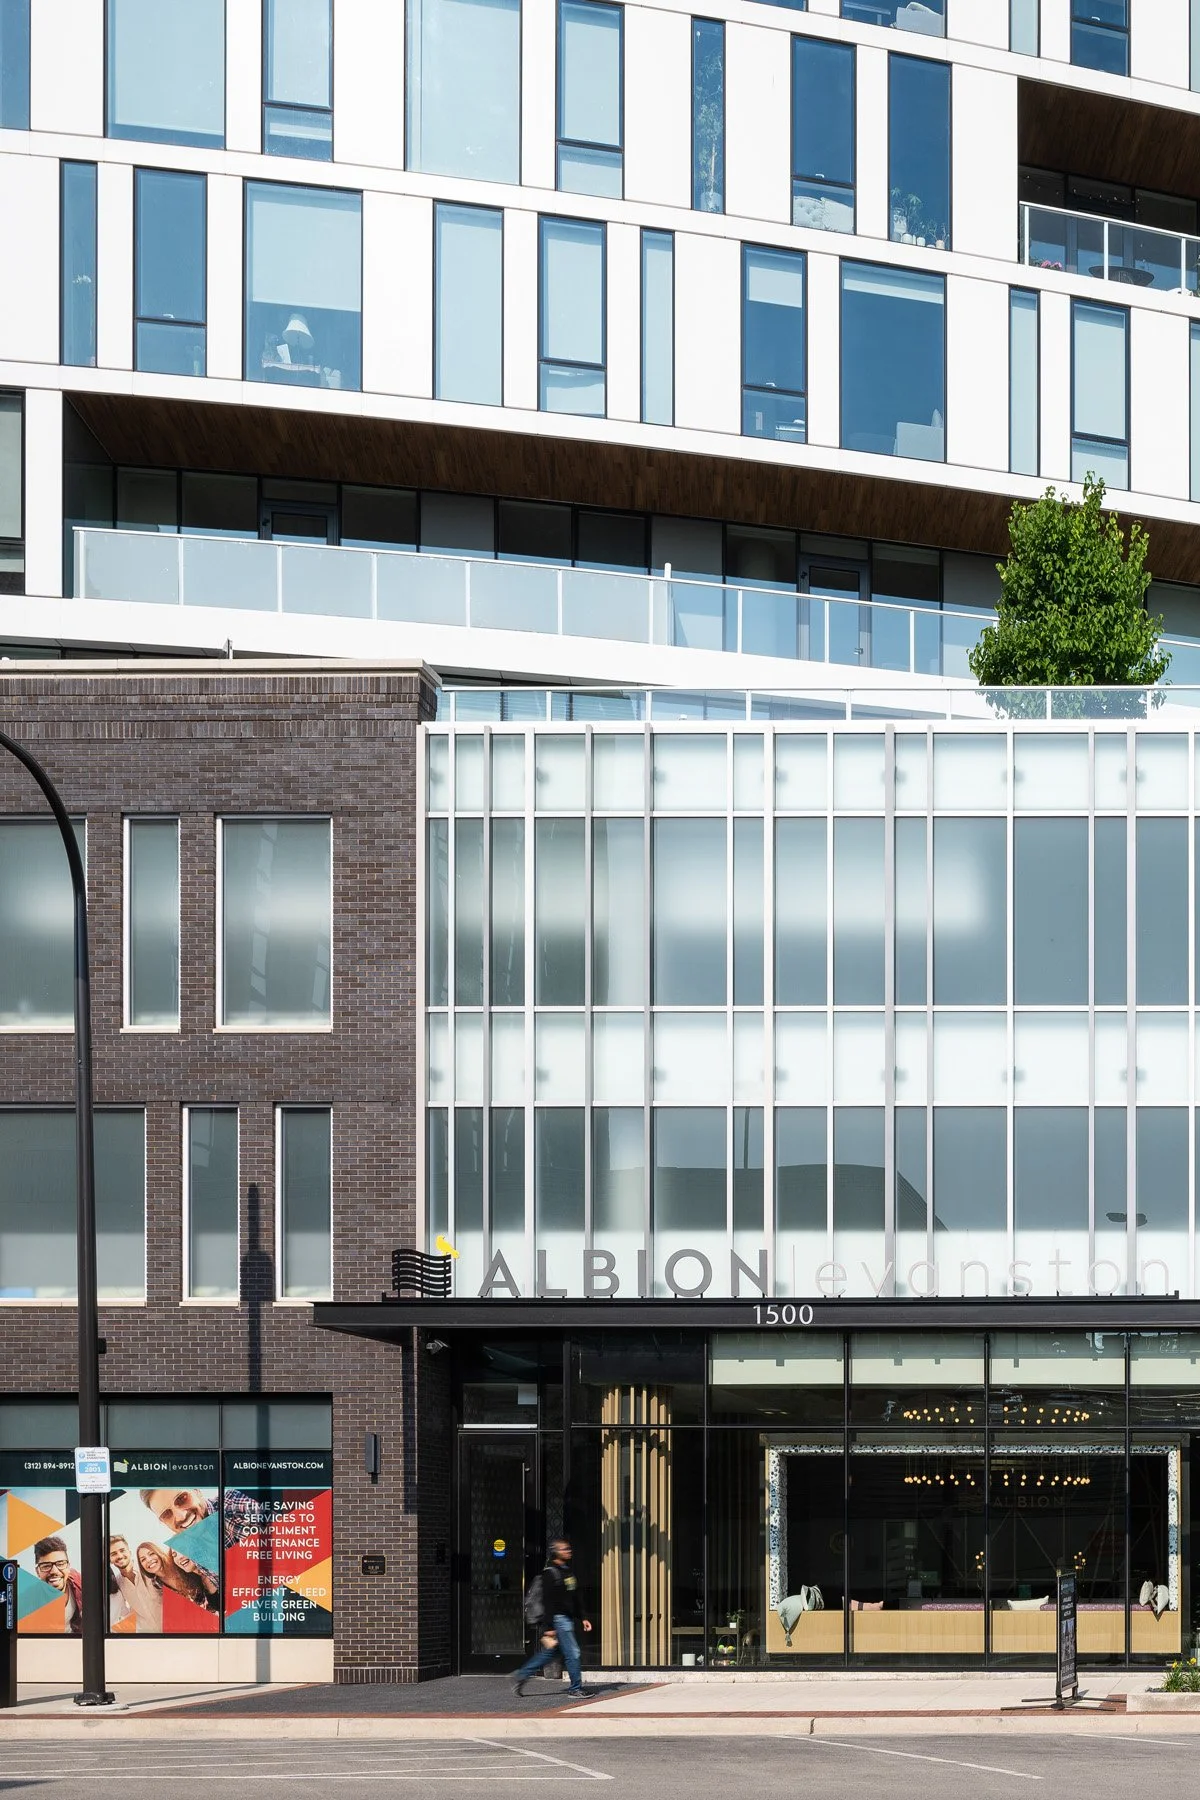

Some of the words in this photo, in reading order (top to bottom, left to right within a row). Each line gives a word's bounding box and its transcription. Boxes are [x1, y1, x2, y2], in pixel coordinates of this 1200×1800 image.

[478, 1249, 768, 1297] ALBION
[815, 1249, 1169, 1297] evanston
[752, 1304, 814, 1325] 1500
[24, 1462, 42, 1470] (312)
[43, 1462, 75, 1470] 894-8912
[131, 1463, 168, 1471] ALBION
[172, 1463, 214, 1471] evanston
[233, 1462, 324, 1470] ALBIONEVANSTON.COM
[245, 1501, 271, 1511] TIME
[273, 1501, 315, 1511] SAVING
[993, 1495, 1065, 1508] ALBION
[243, 1513, 296, 1523] SERVICES
[299, 1513, 315, 1523] TO
[242, 1526, 317, 1535] COMPLIMENT
[239, 1538, 320, 1547] MAINTENANCE
[246, 1550, 273, 1560] FREE
[275, 1550, 313, 1560] LIVING
[257, 1575, 301, 1585] ENERGY
[232, 1587, 287, 1597] EFFICIENT
[299, 1587, 327, 1597] LEED
[241, 1600, 278, 1609] SILVER
[280, 1600, 317, 1609] GREEN
[253, 1612, 306, 1622] BUILDING
